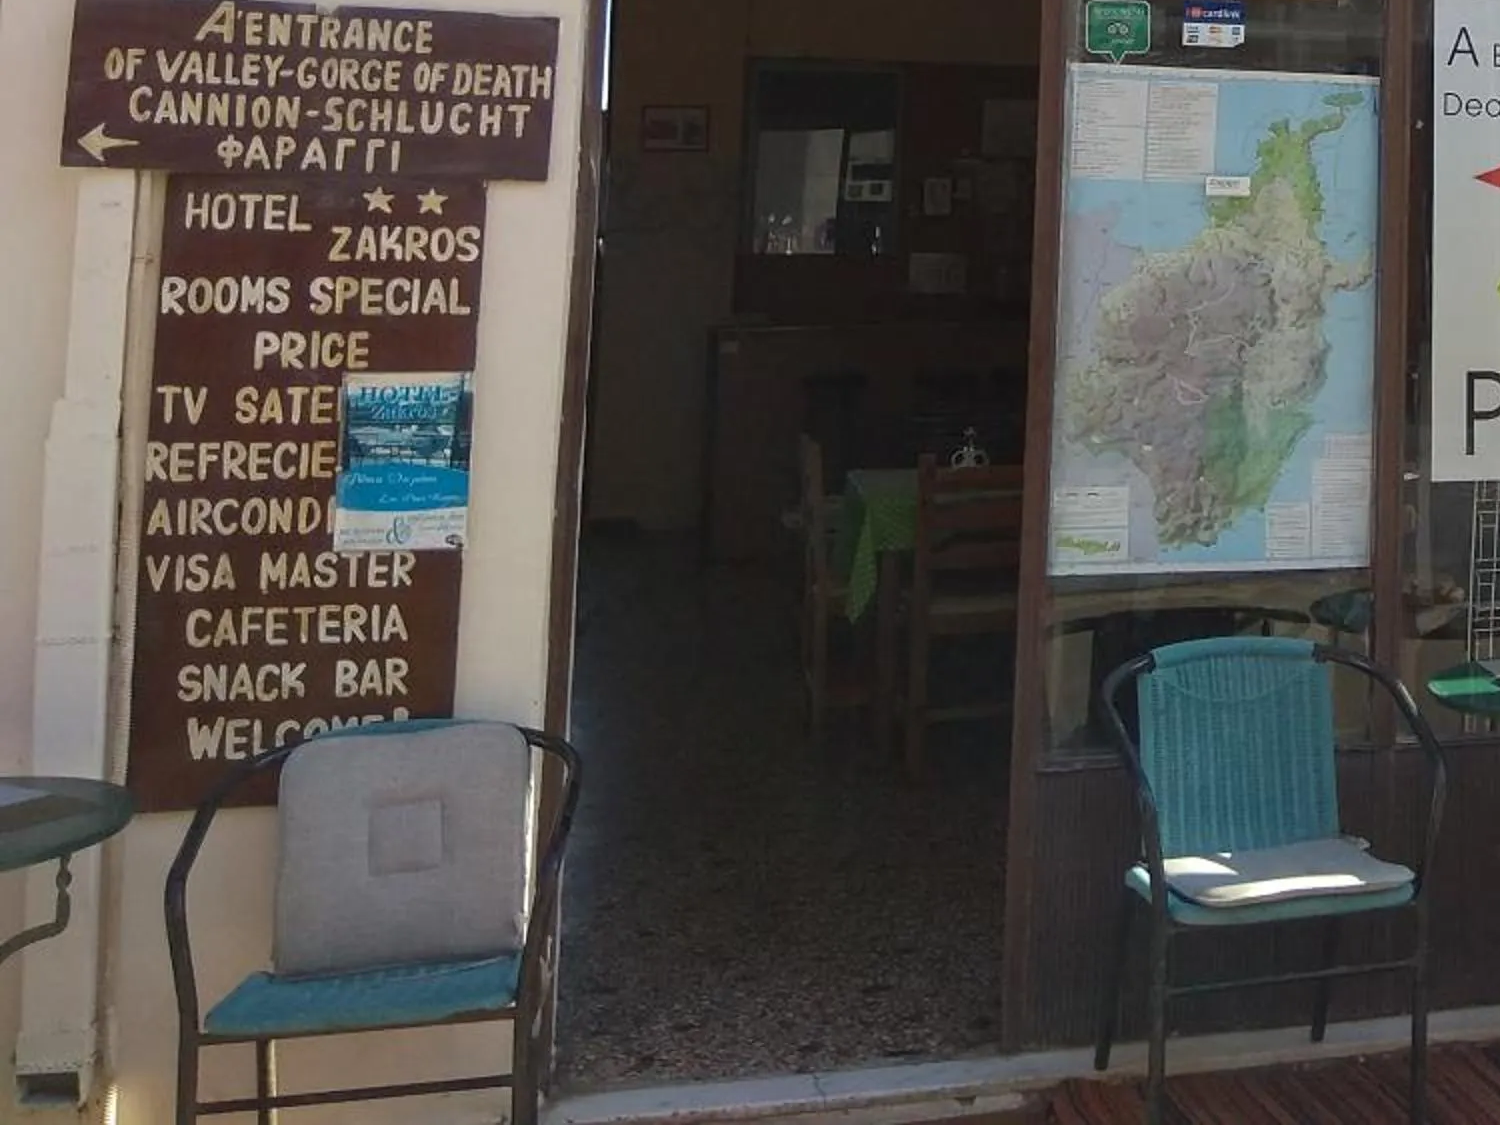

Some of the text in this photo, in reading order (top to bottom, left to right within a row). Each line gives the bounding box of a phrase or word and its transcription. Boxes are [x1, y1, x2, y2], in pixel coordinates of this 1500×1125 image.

[1447, 26, 1478, 67] A
[104, 48, 147, 80] OF
[413, 62, 444, 92] OF
[452, 62, 555, 100] DEATH
[217, 135, 401, 173] ΦΑΡΑΓΓΙ
[186, 192, 481, 263] HOTEL ZAKROS
[161, 276, 471, 317] ROOMS SPECIAL
[254, 331, 370, 370] PRICE
[157, 385, 341, 425] TV SATE
[146, 551, 417, 594] VISA MASTER
[185, 604, 409, 648] CAFETERIA
[177, 658, 410, 702] SNACK BAR
